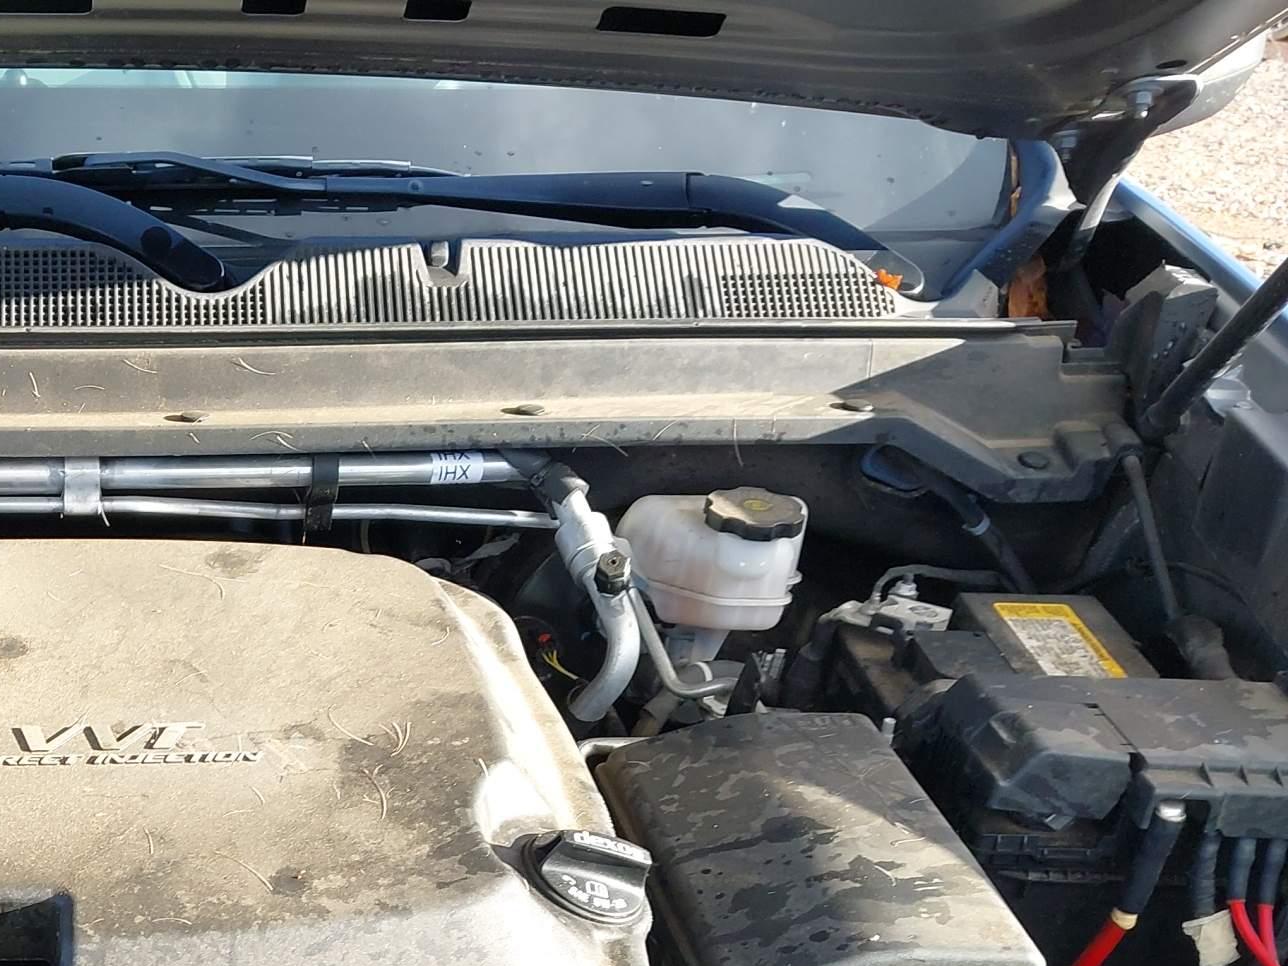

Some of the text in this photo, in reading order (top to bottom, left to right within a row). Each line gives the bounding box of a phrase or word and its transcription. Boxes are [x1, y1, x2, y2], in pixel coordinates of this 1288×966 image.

[438, 464, 472, 481] IHX
[10, 721, 206, 752] VVT
[85, 751, 263, 766] INJECTION
